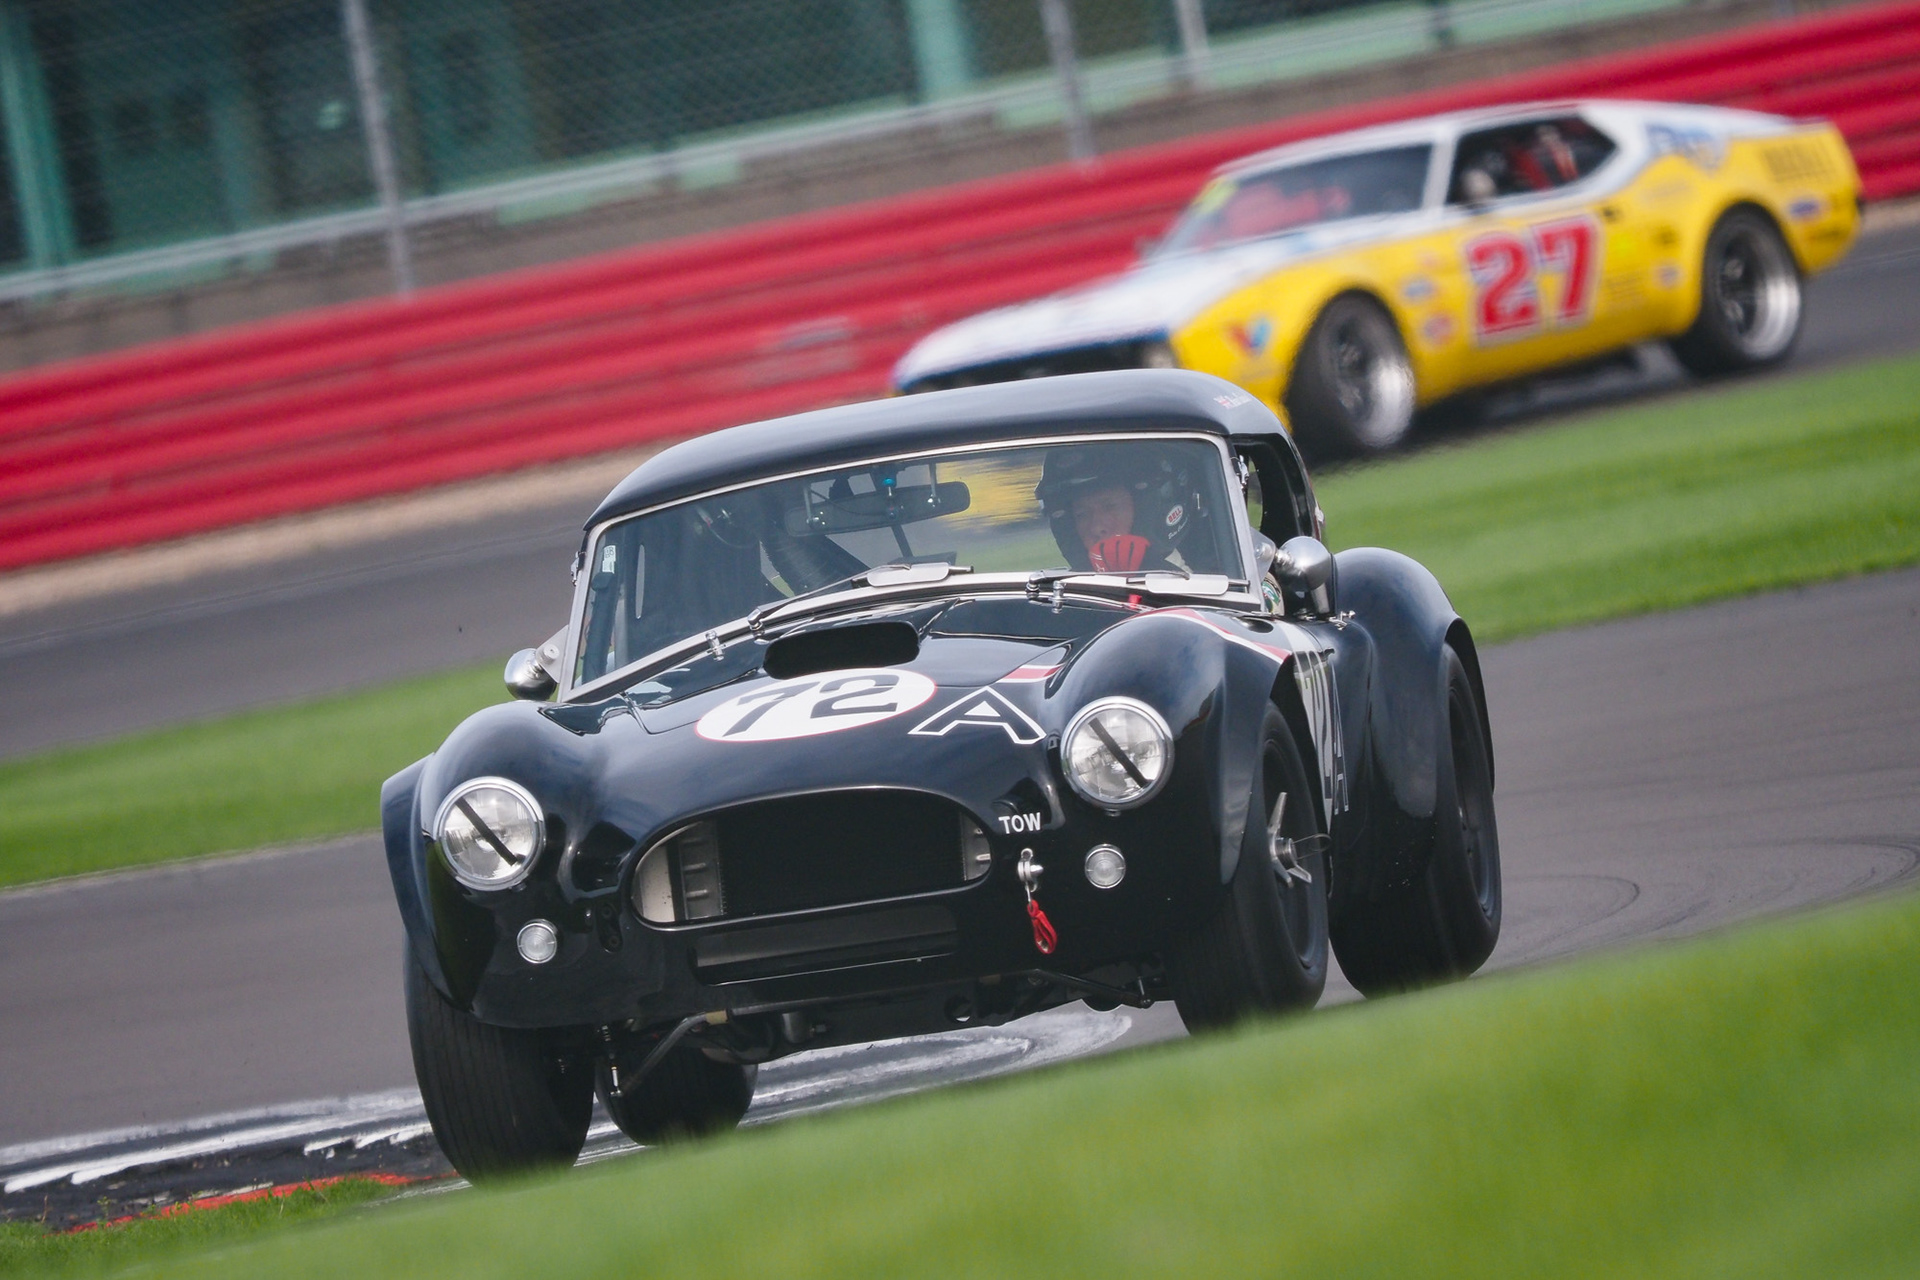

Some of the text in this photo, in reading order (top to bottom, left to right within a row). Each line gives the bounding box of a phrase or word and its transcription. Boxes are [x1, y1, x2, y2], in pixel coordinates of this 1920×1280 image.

[1468, 217, 1596, 337] 27
[1167, 507, 1182, 523] BELL
[723, 674, 1047, 745] 72 A
[998, 812, 1041, 834] TOW
